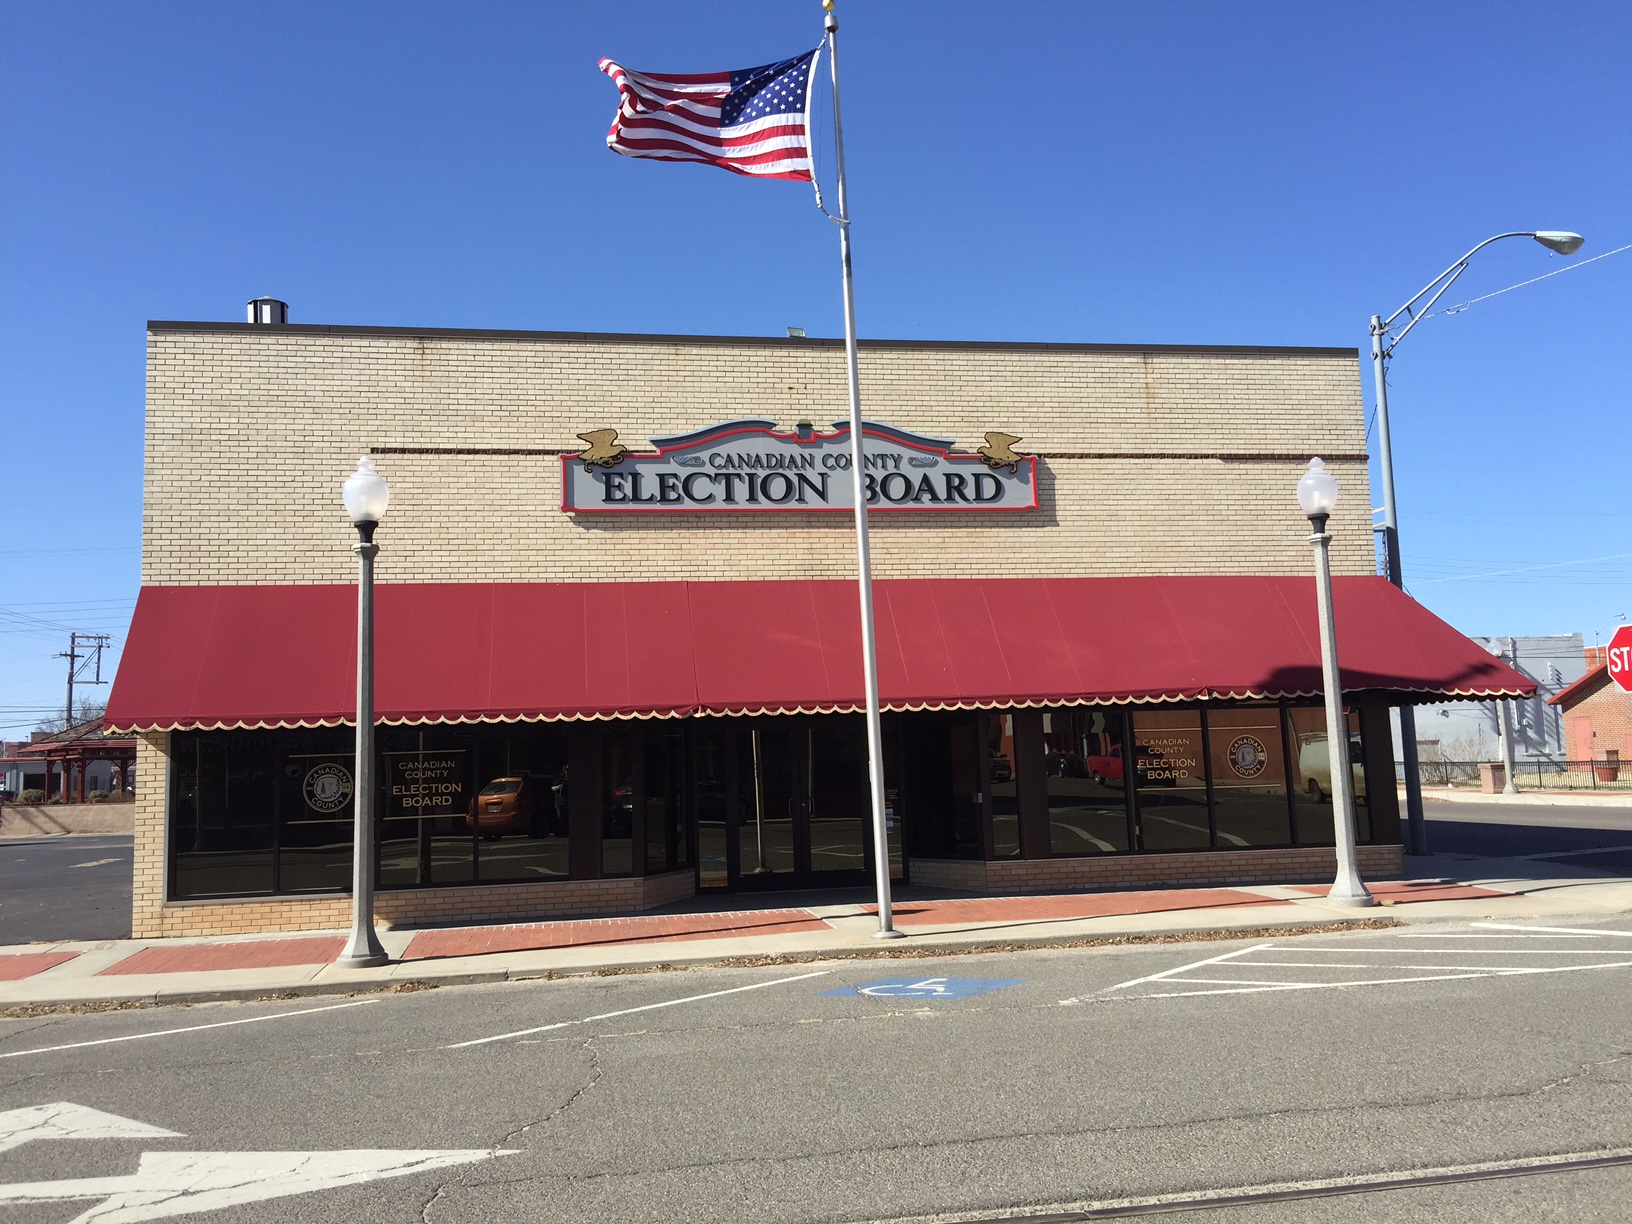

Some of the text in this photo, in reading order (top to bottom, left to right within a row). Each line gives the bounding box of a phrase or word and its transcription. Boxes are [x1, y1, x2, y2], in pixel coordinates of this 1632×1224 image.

[709, 453, 816, 468] CANADIAN
[601, 472, 827, 502] ELECTION
[1610, 647, 1632, 673] ST
[1142, 738, 1190, 746] CANADIAN
[1231, 738, 1262, 752] CANADIAN
[1148, 746, 1184, 754] COUNTY
[398, 761, 455, 770] CANADIAN
[1138, 758, 1196, 768] ELECTION
[404, 770, 449, 779] COUNTY
[1147, 769, 1188, 780] BOARD
[1235, 764, 1262, 775] COUNTY
[308, 767, 349, 784] CANADIAN
[392, 783, 462, 795] ELECTION
[311, 796, 344, 809] COUNTY
[402, 796, 452, 807] BOARD
